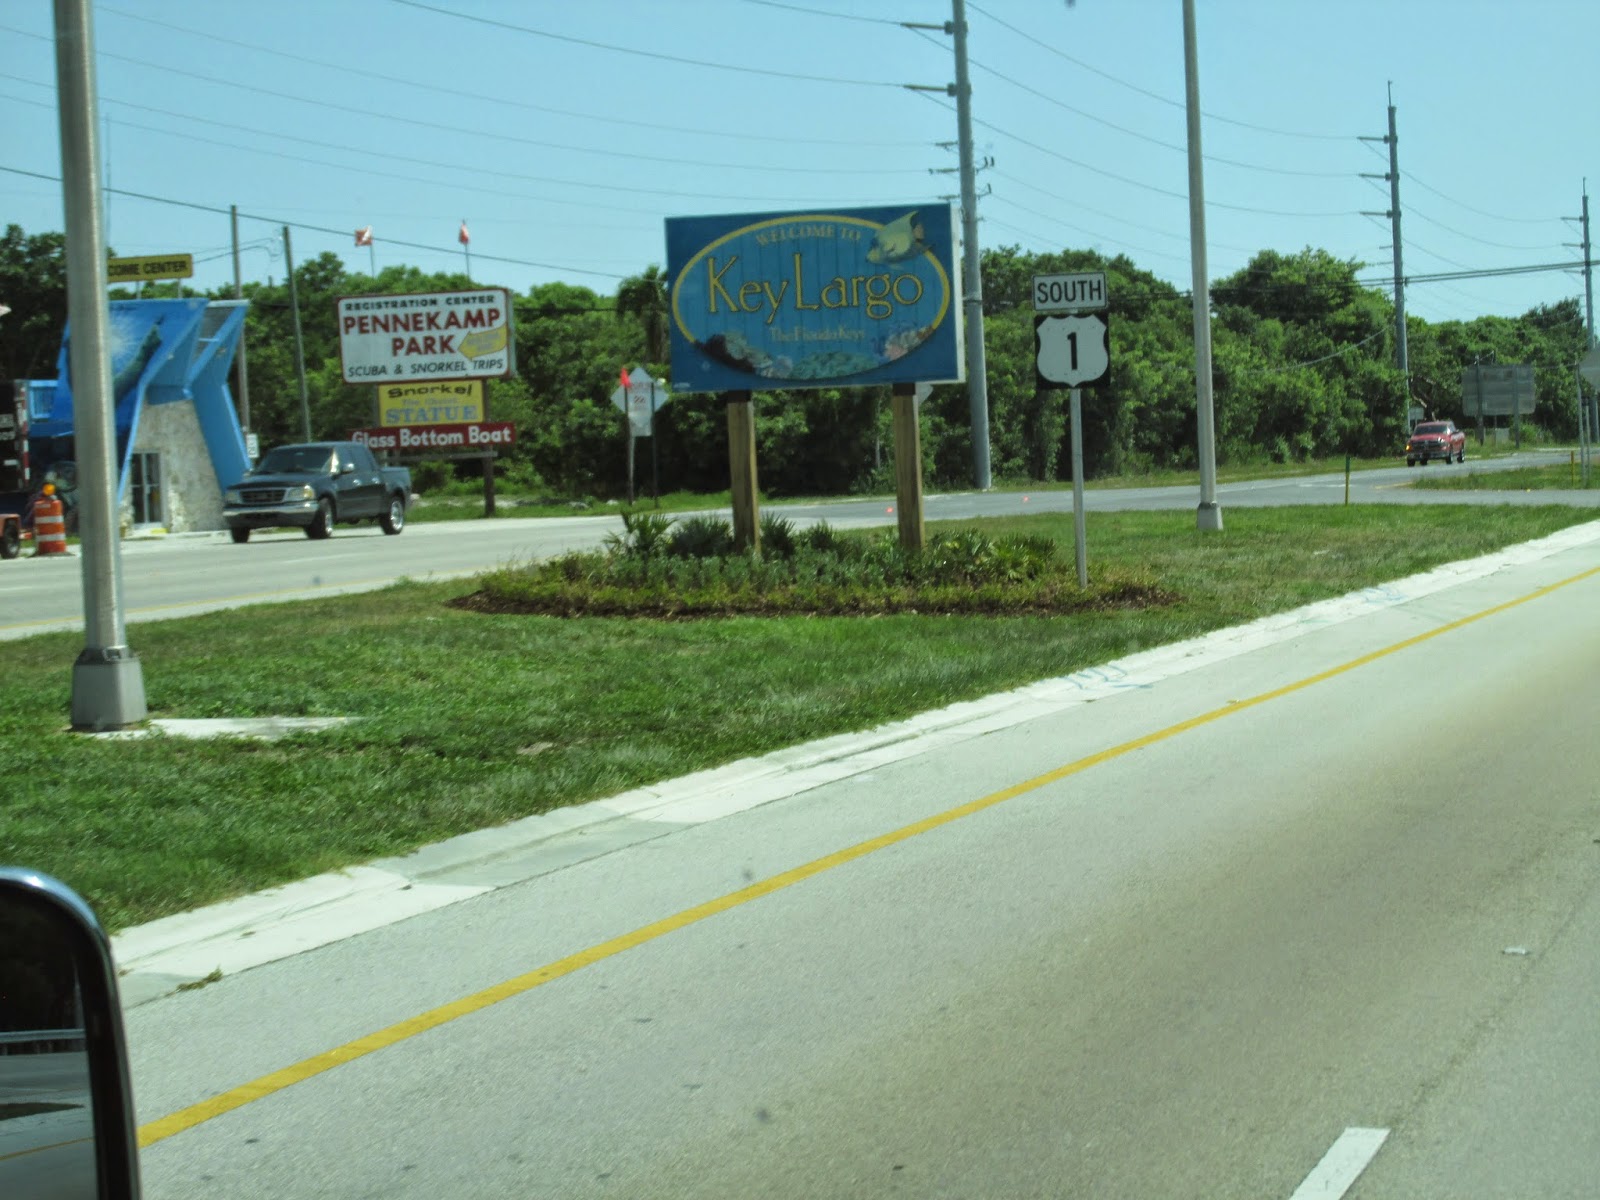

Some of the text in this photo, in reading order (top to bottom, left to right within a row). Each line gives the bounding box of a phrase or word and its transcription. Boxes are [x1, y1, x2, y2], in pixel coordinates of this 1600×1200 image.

[755, 224, 862, 246] WELCOME TO
[143, 261, 187, 274] CENTER
[706, 252, 923, 325] Key Largo
[1037, 280, 1102, 303] SOUTH
[345, 295, 495, 311] REGISTRATION CENTER
[343, 308, 500, 335] PENNEKAMP
[392, 335, 456, 357] PARK
[1067, 332, 1078, 371] 1
[348, 358, 503, 377] SCUBA & SNORKEL TRIPS
[388, 384, 473, 398] Snorkel
[386, 405, 478, 424] STATUE
[352, 425, 512, 448] Glass Bottom Boat
